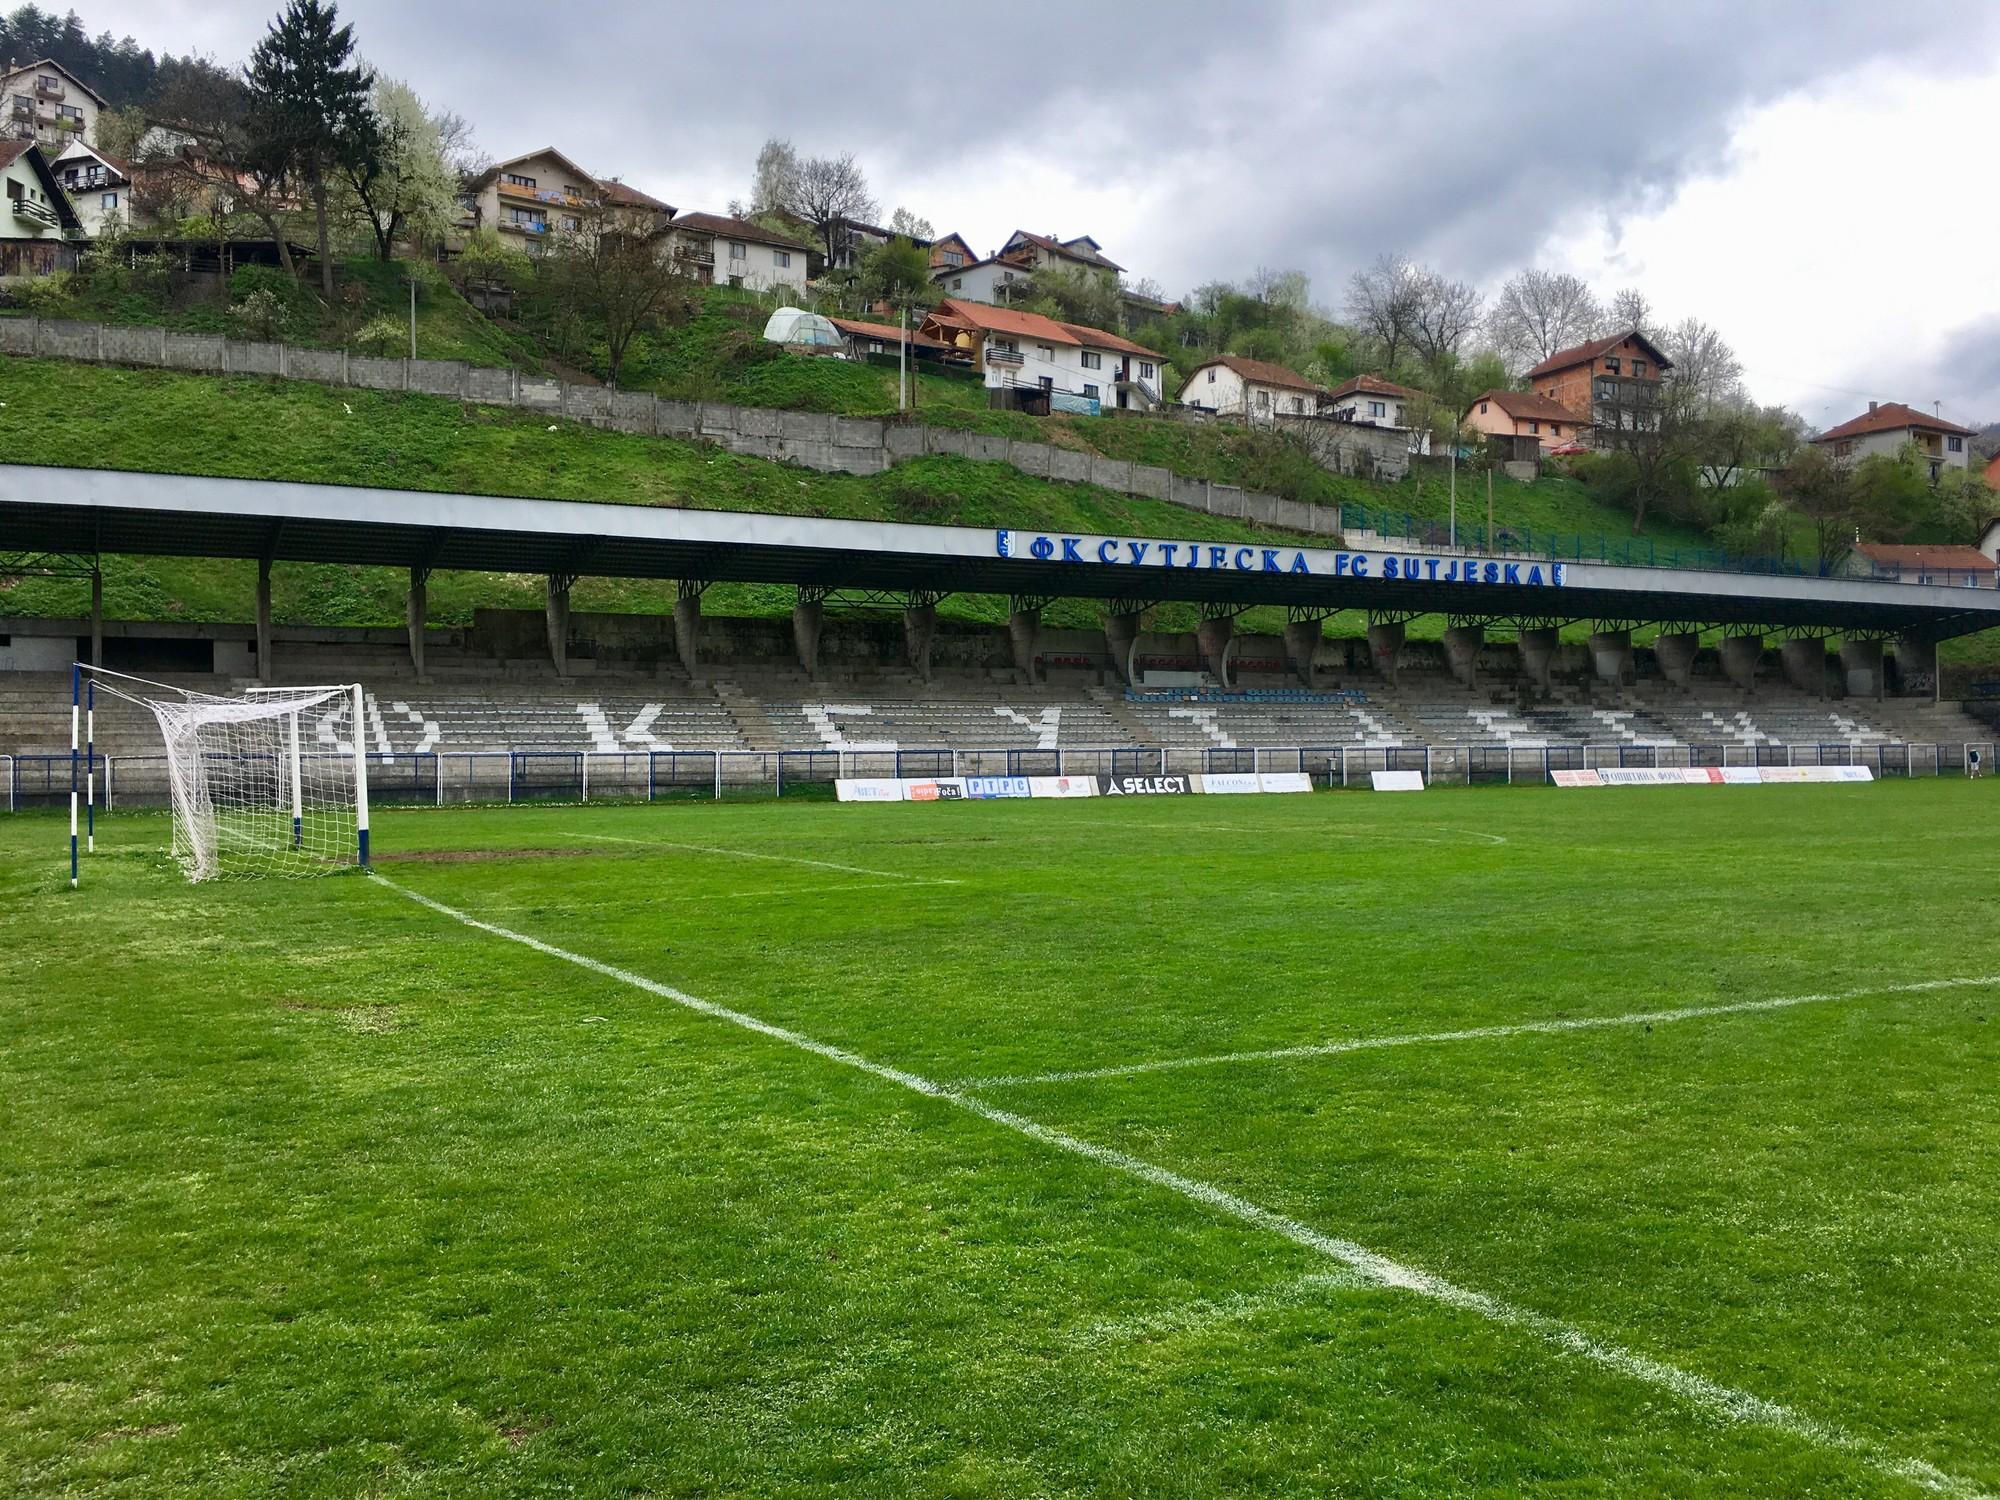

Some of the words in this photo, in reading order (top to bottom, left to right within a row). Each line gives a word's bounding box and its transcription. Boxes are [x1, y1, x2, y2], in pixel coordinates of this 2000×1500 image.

[1030, 536, 1083, 563] ФК
[1099, 539, 1310, 575] СУТЈЕСКА
[1335, 553, 1368, 578] FC
[1384, 556, 1545, 587] SUTJESKA
[936, 786, 961, 796] Foča!
[1123, 777, 1185, 794] SELECT
